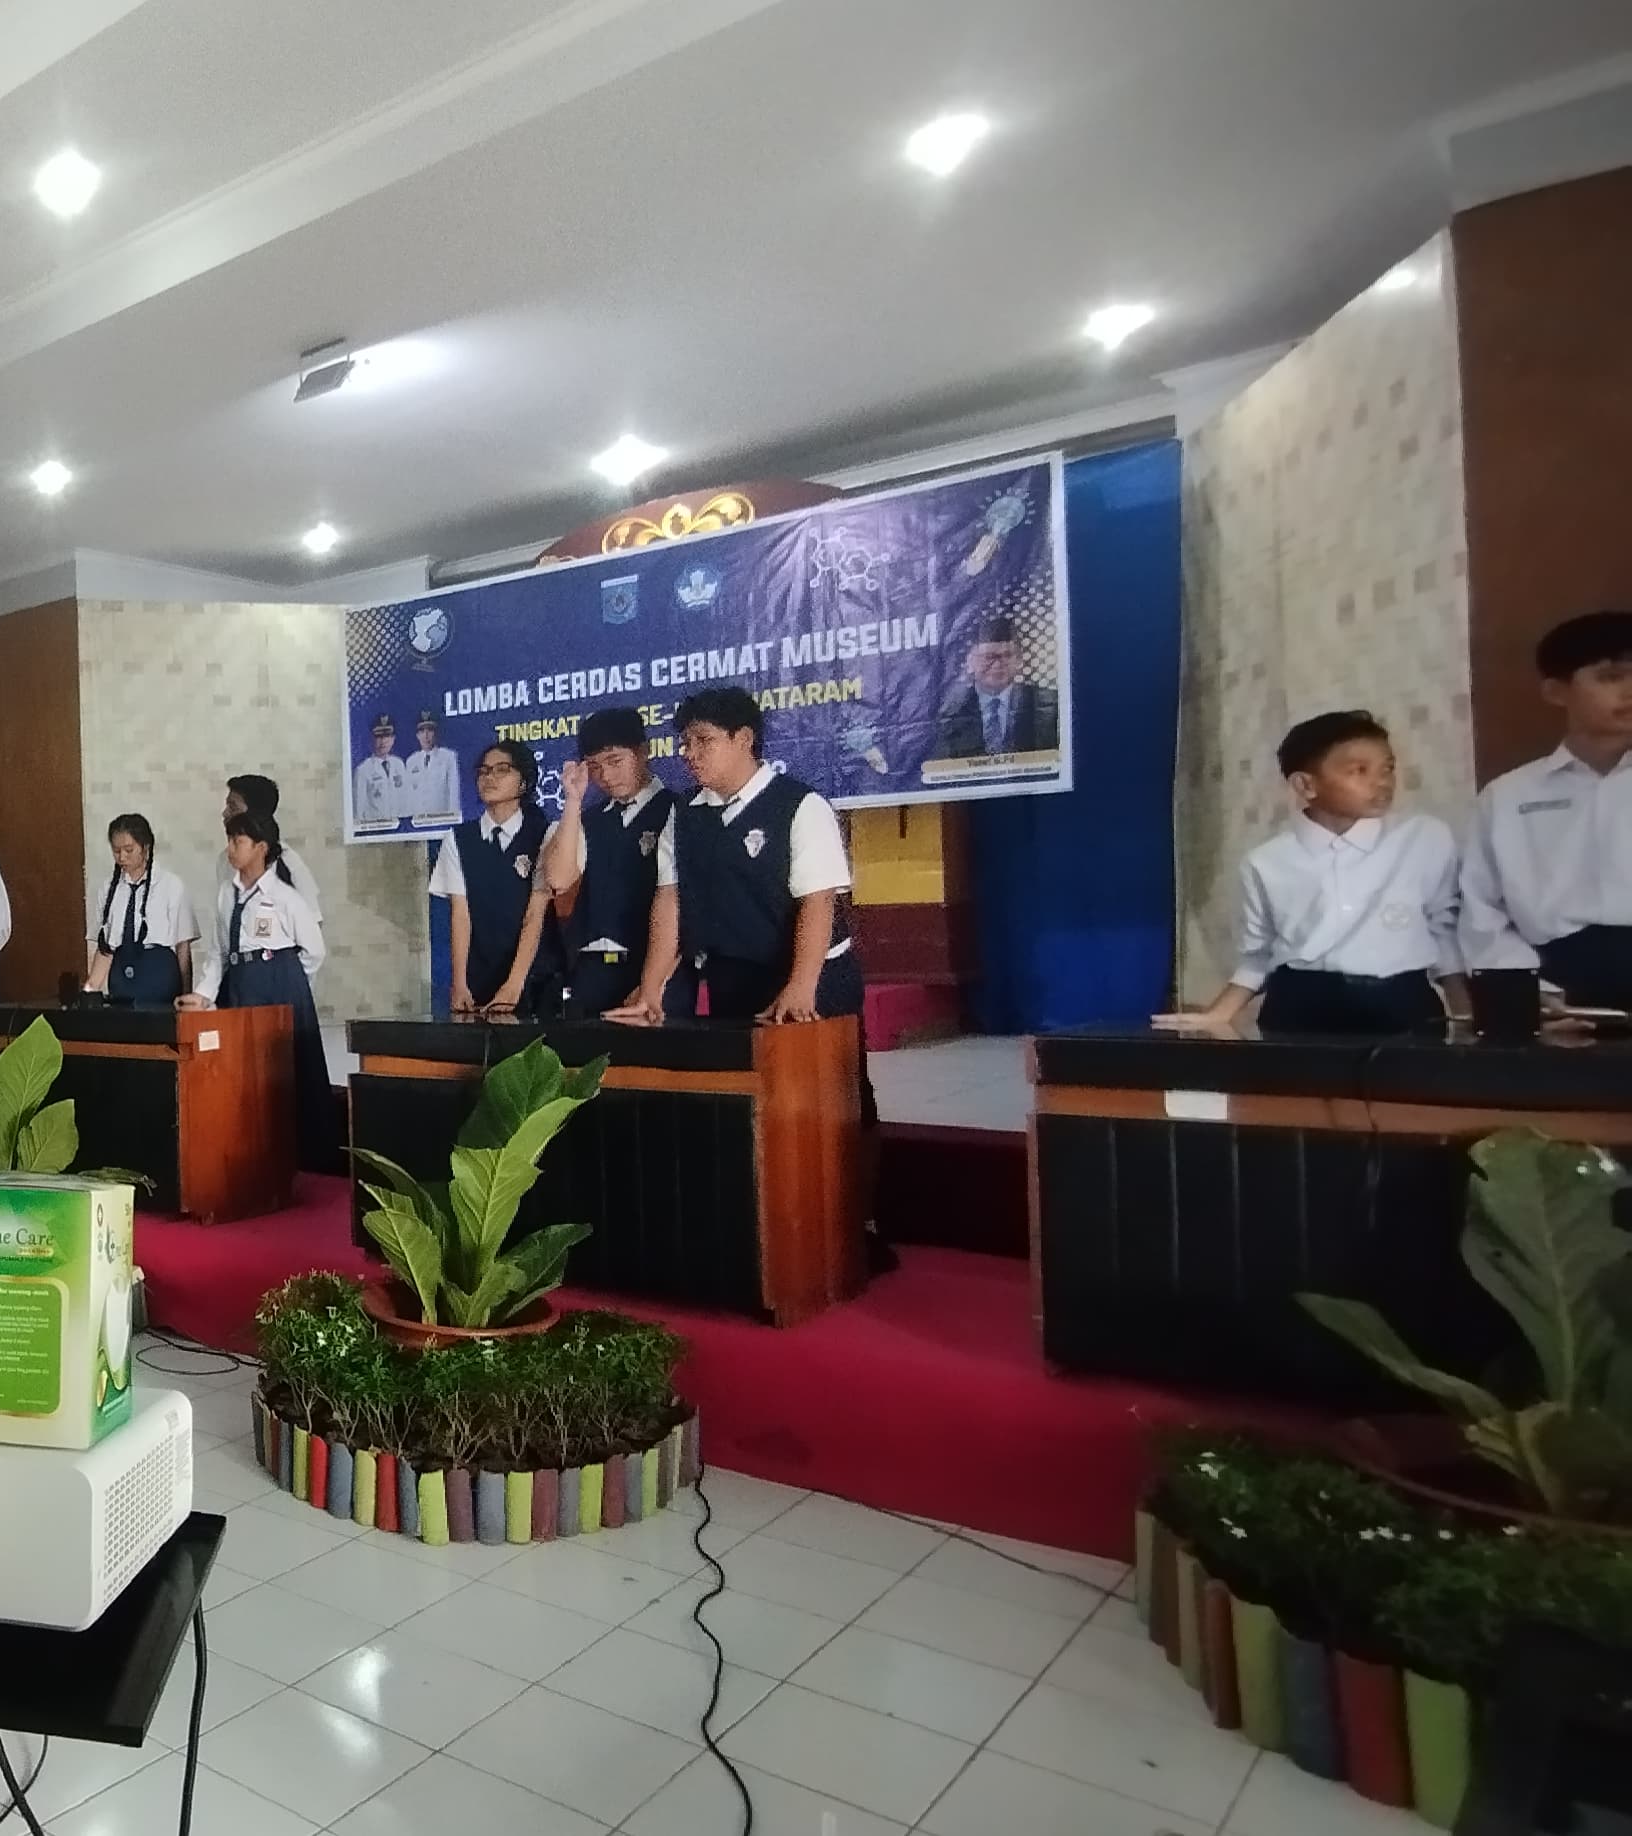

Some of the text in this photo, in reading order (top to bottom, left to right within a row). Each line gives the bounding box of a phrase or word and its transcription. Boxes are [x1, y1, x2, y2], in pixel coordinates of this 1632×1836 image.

[444, 613, 938, 717] LOMBA CERDAS CERMAT MUSEUM
[494, 715, 581, 743] TINGKAT
[15, 1227, 54, 1246] Care
